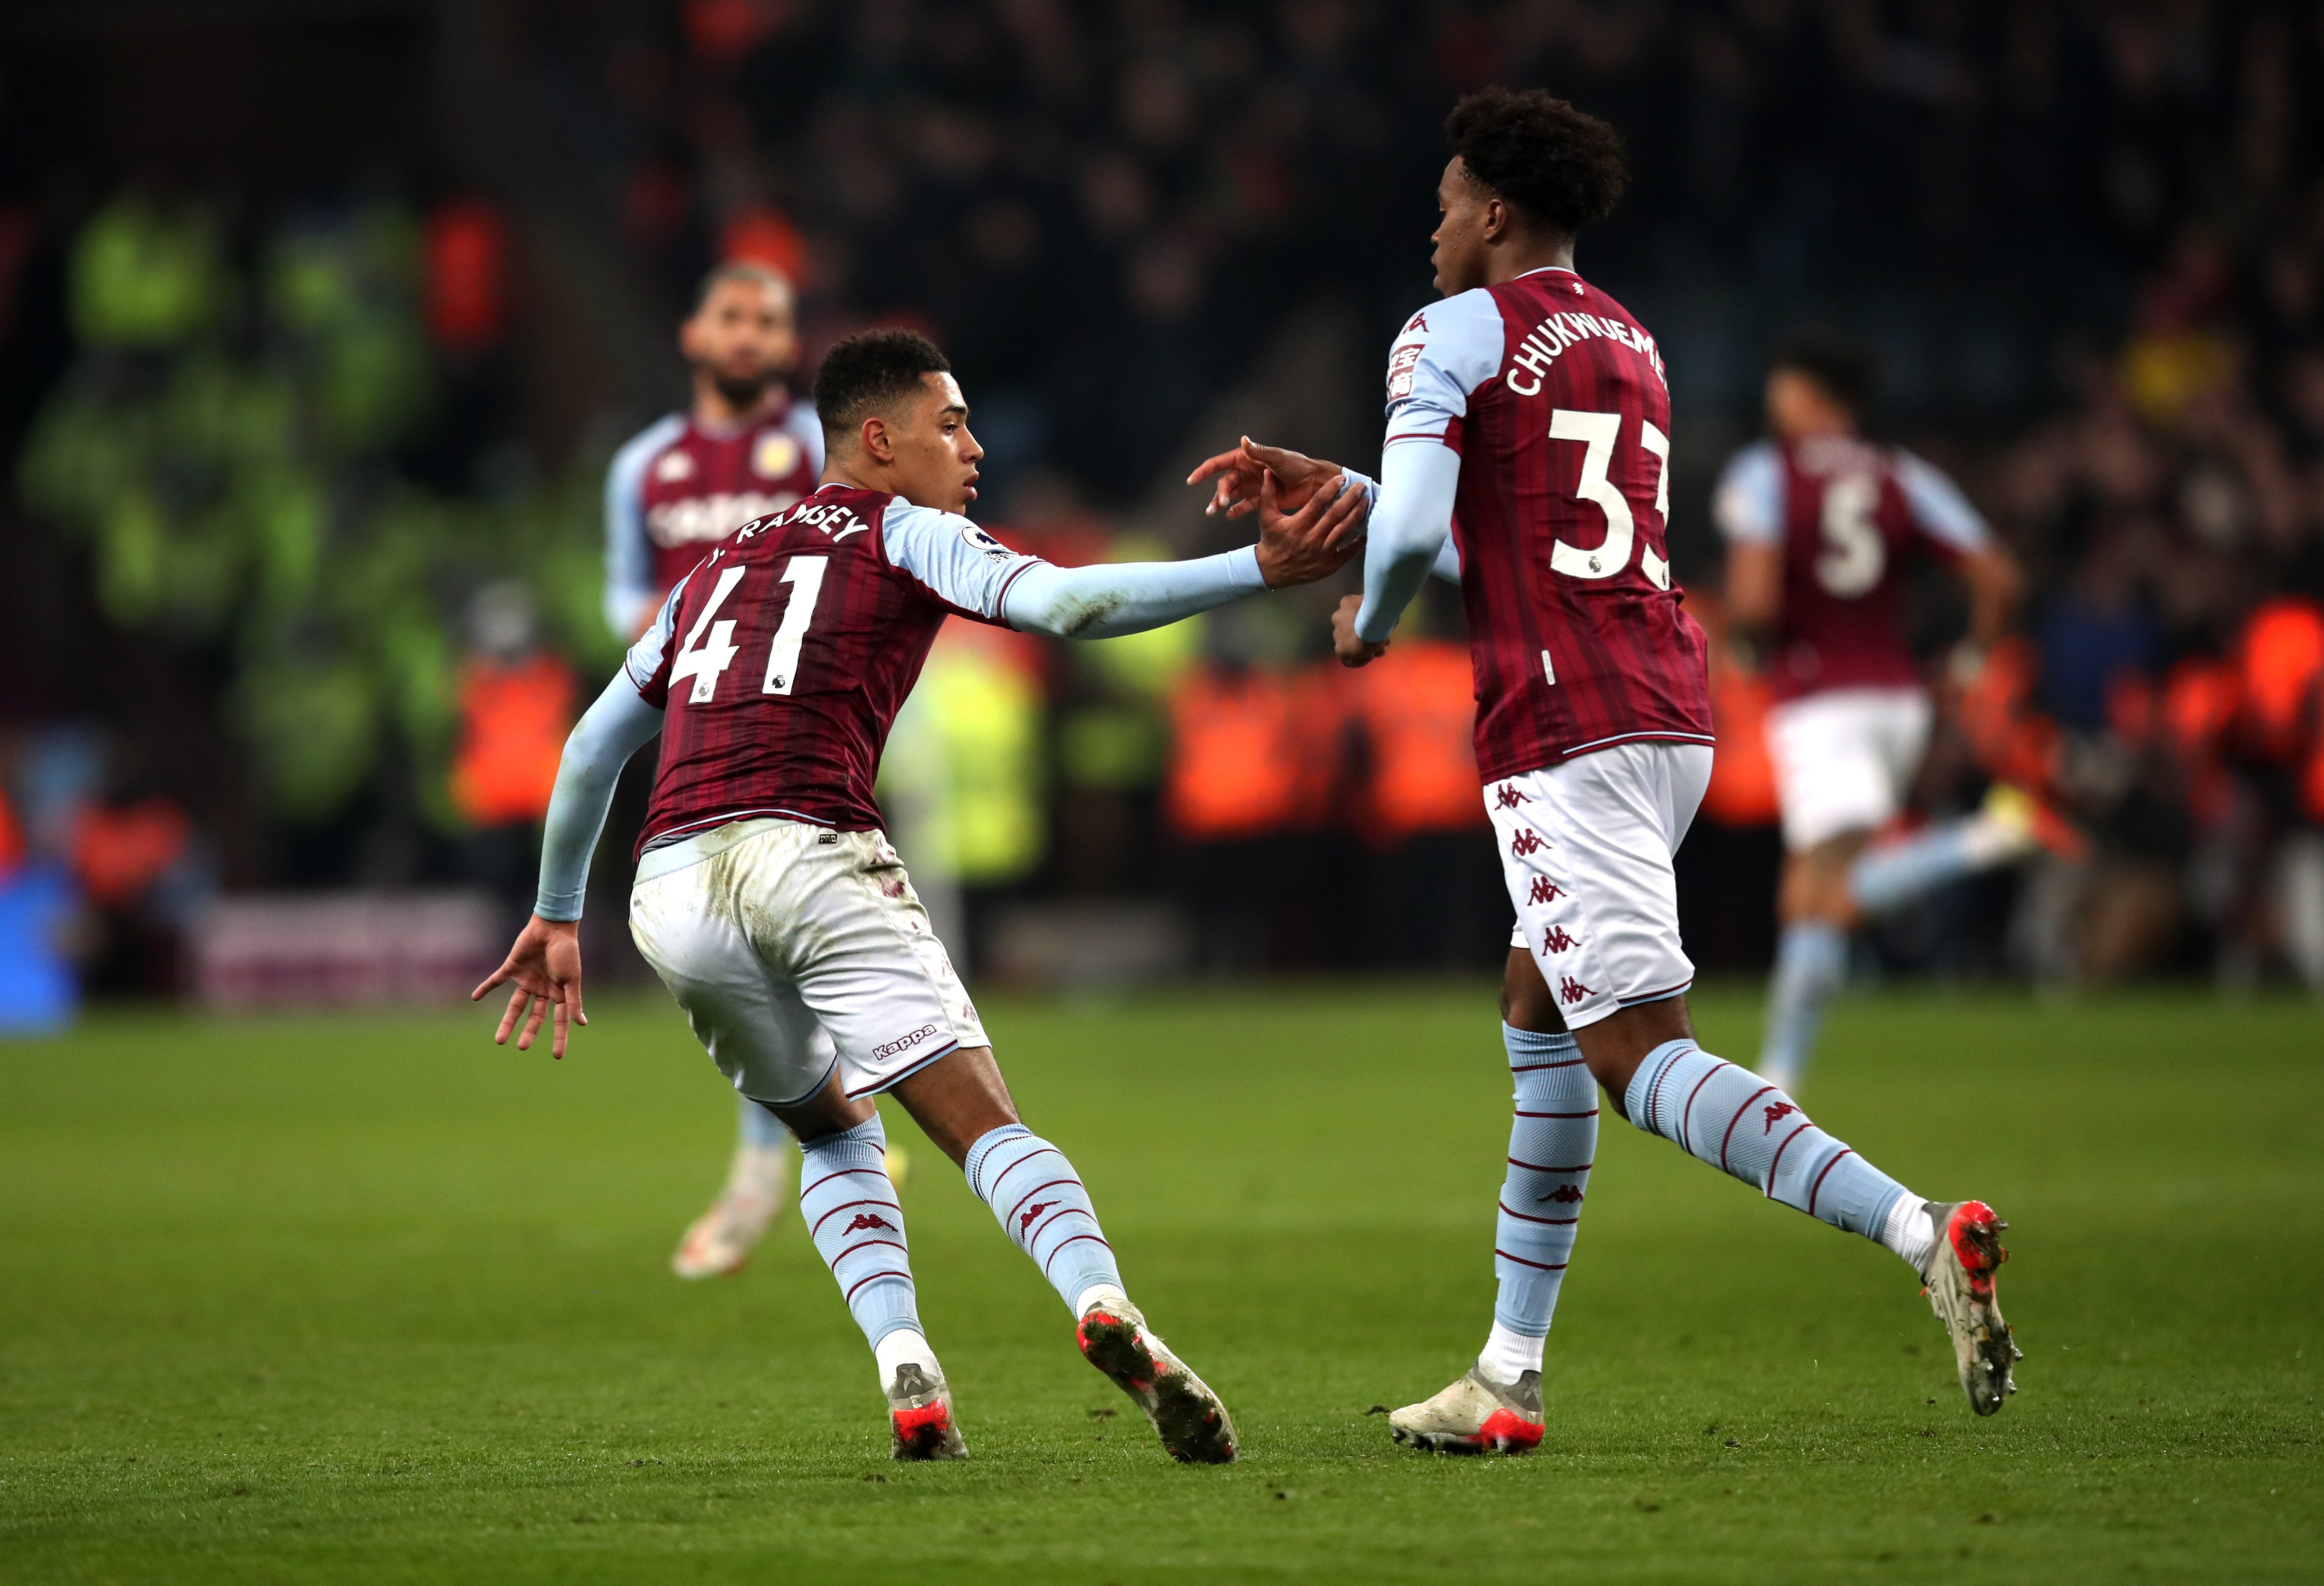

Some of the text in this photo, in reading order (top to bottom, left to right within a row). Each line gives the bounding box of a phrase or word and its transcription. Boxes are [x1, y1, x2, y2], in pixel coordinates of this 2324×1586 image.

[1507, 312, 1670, 403] CHUKWUEME
[736, 504, 869, 544] RAMSEY
[1549, 409, 1670, 591] 33
[668, 556, 829, 704] 41
[872, 1024, 937, 1061] Kappa
